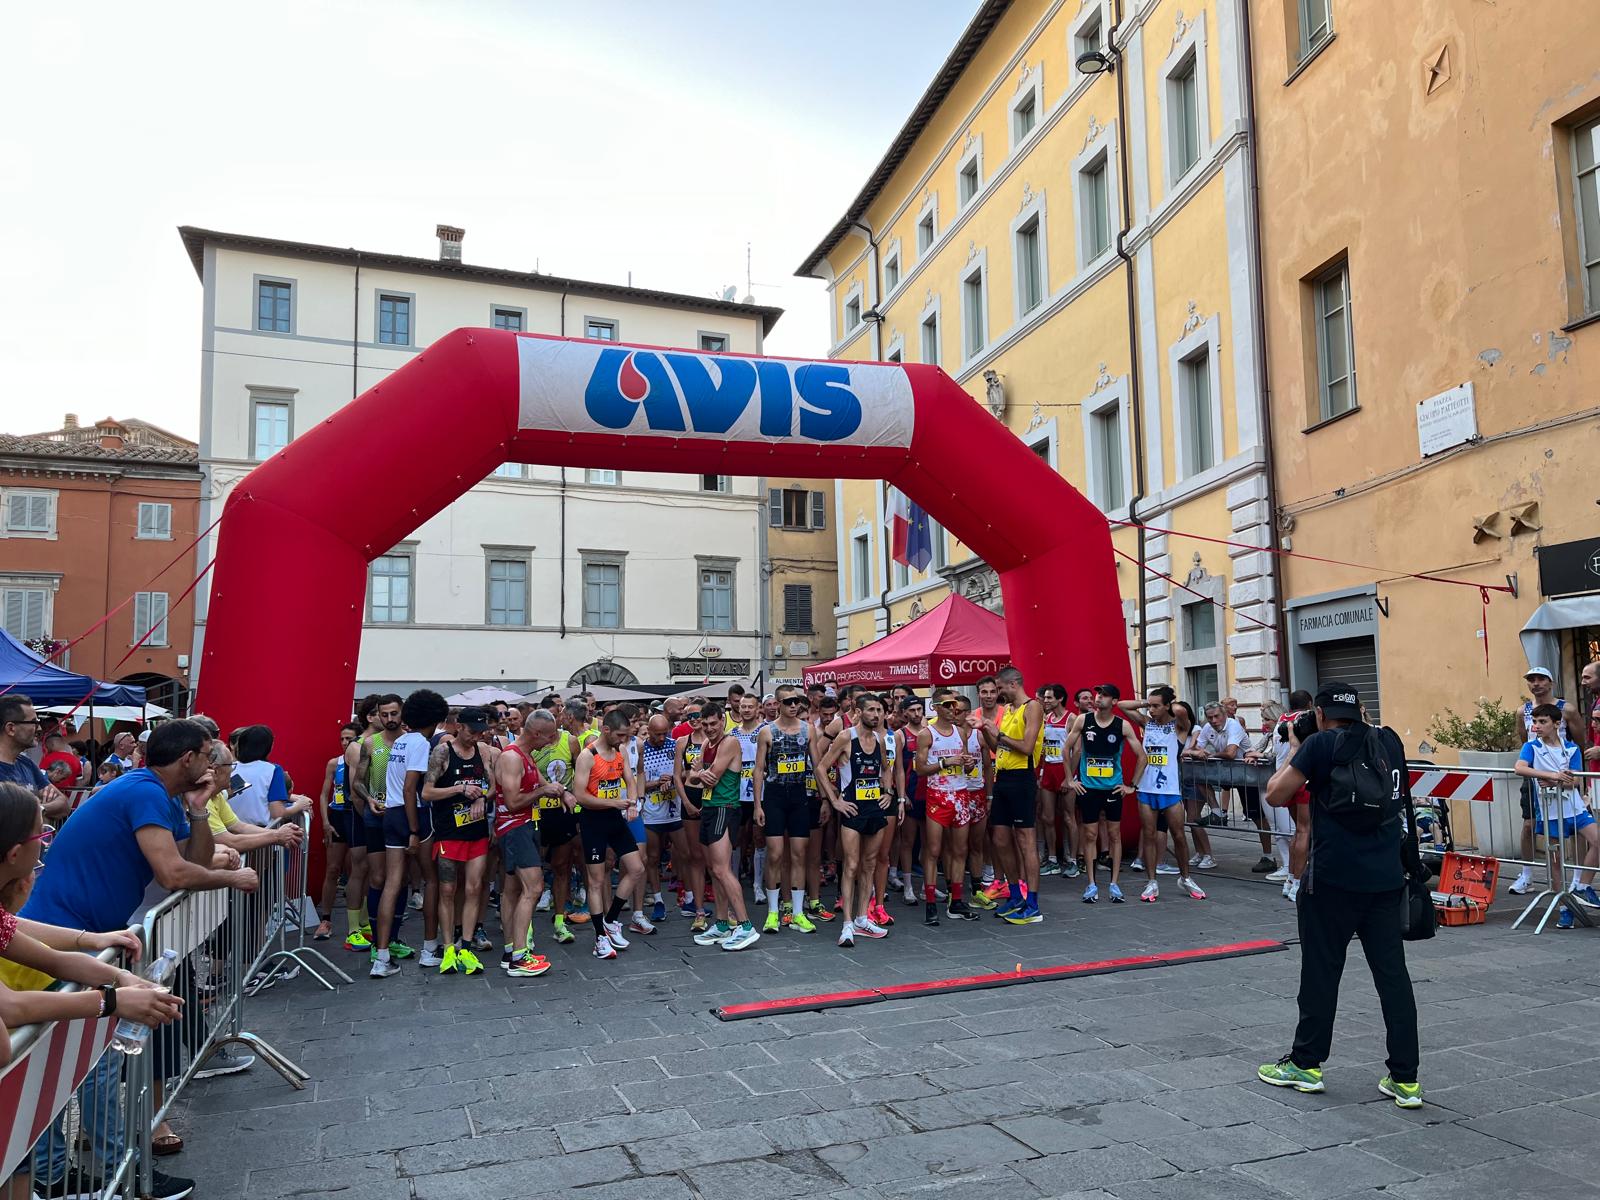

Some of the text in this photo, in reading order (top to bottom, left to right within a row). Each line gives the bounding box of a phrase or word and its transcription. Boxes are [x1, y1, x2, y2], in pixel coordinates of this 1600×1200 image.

[584, 348, 863, 441] AVIS
[1300, 607, 1374, 631] FARMACIA COMUNALE
[673, 662, 703, 674] BAR
[837, 671, 885, 681] PROFESSIONAL
[889, 664, 918, 675] TIMING
[785, 763, 798, 772] 90
[1097, 767, 1102, 777] 1
[603, 788, 619, 799] 133
[656, 791, 673, 802] 123
[865, 789, 876, 799] 46
[545, 797, 559, 808] 63
[1452, 885, 1465, 894] 110
